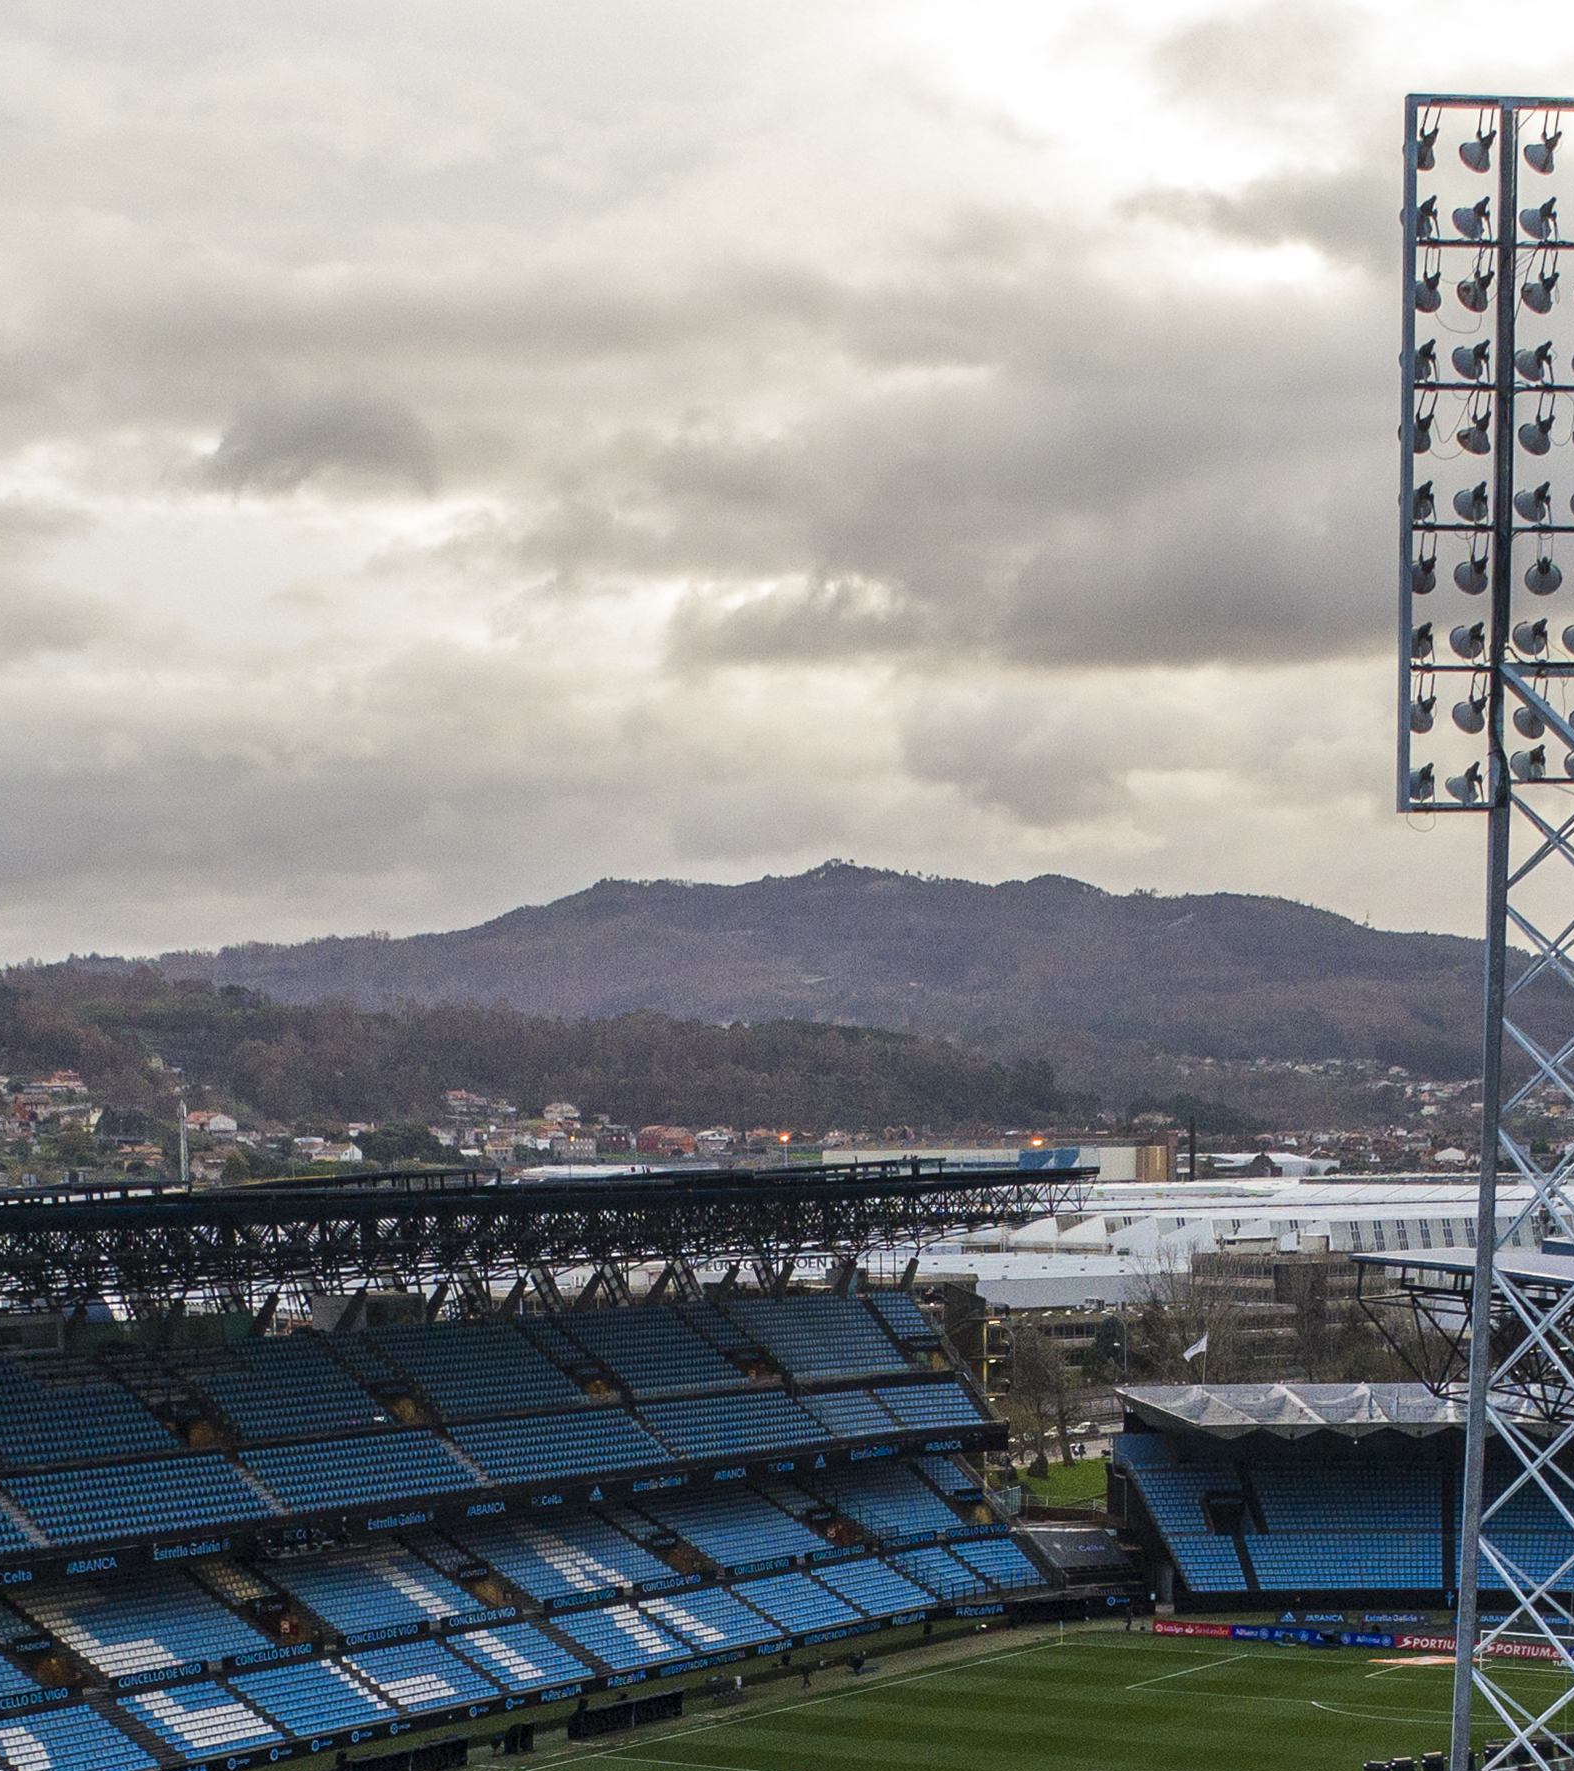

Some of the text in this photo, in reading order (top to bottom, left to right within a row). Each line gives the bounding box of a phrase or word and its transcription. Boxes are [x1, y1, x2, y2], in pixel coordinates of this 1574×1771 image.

[346, 1623, 418, 1647] CONCELLO DE VIGO
[235, 1642, 313, 1667] CONCELLO DE VIGO
[117, 1663, 202, 1688] CONCELLO DE VIGO
[30, 1691, 42, 1704] DE
[43, 1687, 68, 1703] VIGO
